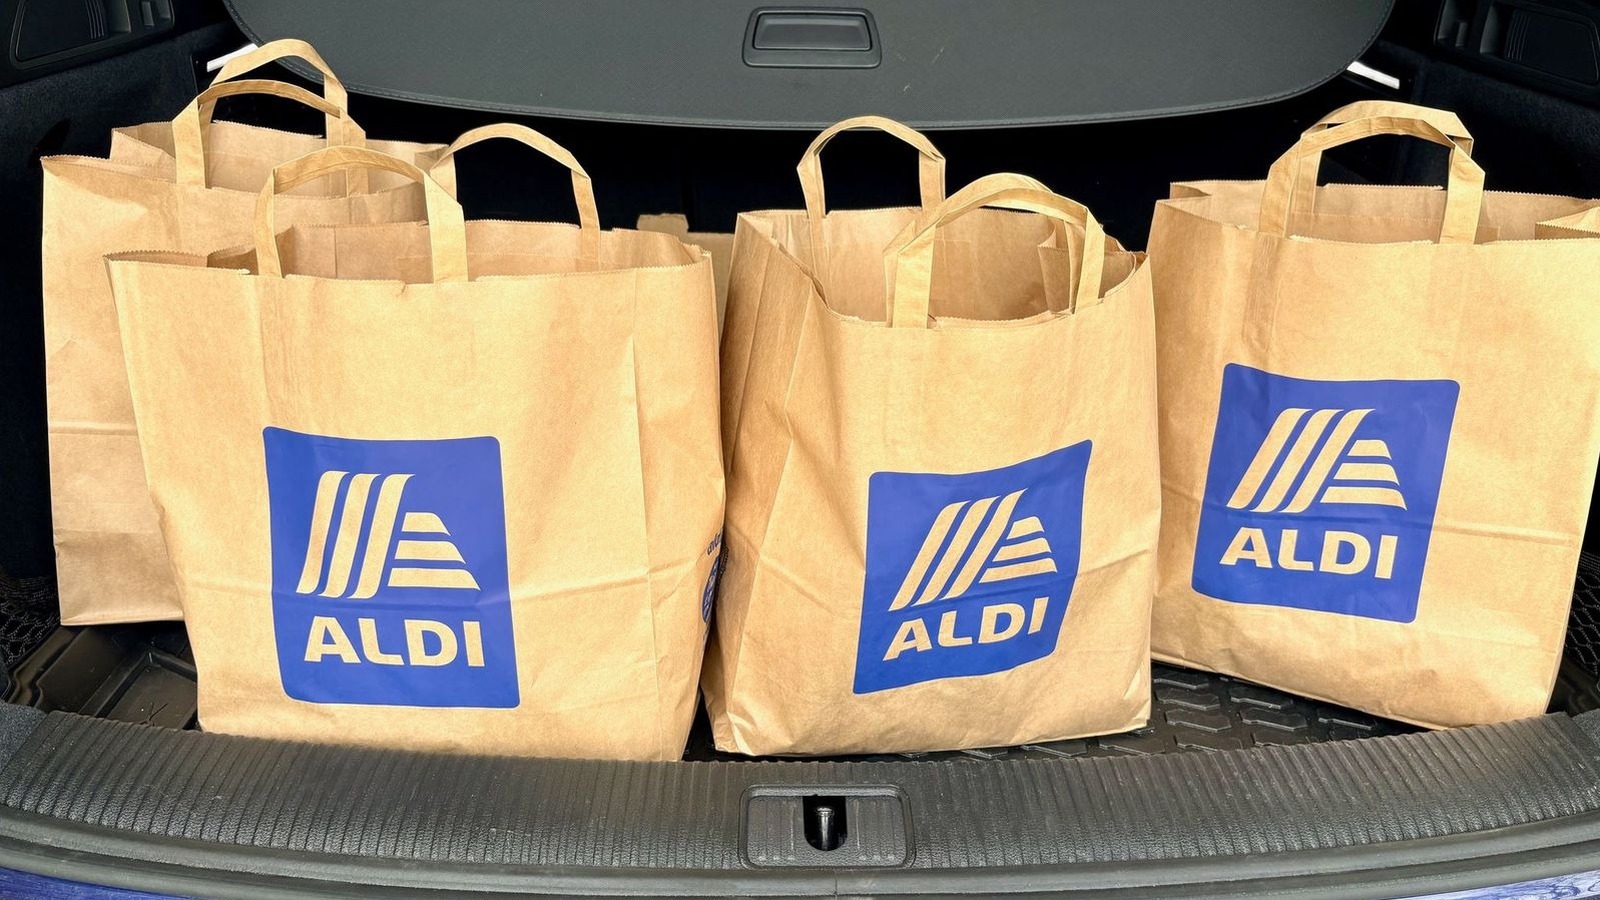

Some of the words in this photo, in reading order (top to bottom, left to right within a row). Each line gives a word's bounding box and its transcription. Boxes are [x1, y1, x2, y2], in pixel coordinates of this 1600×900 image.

[1221, 527, 1397, 579] ALDI
[305, 616, 484, 668] ALDI
[884, 597, 1049, 661] ALDI
